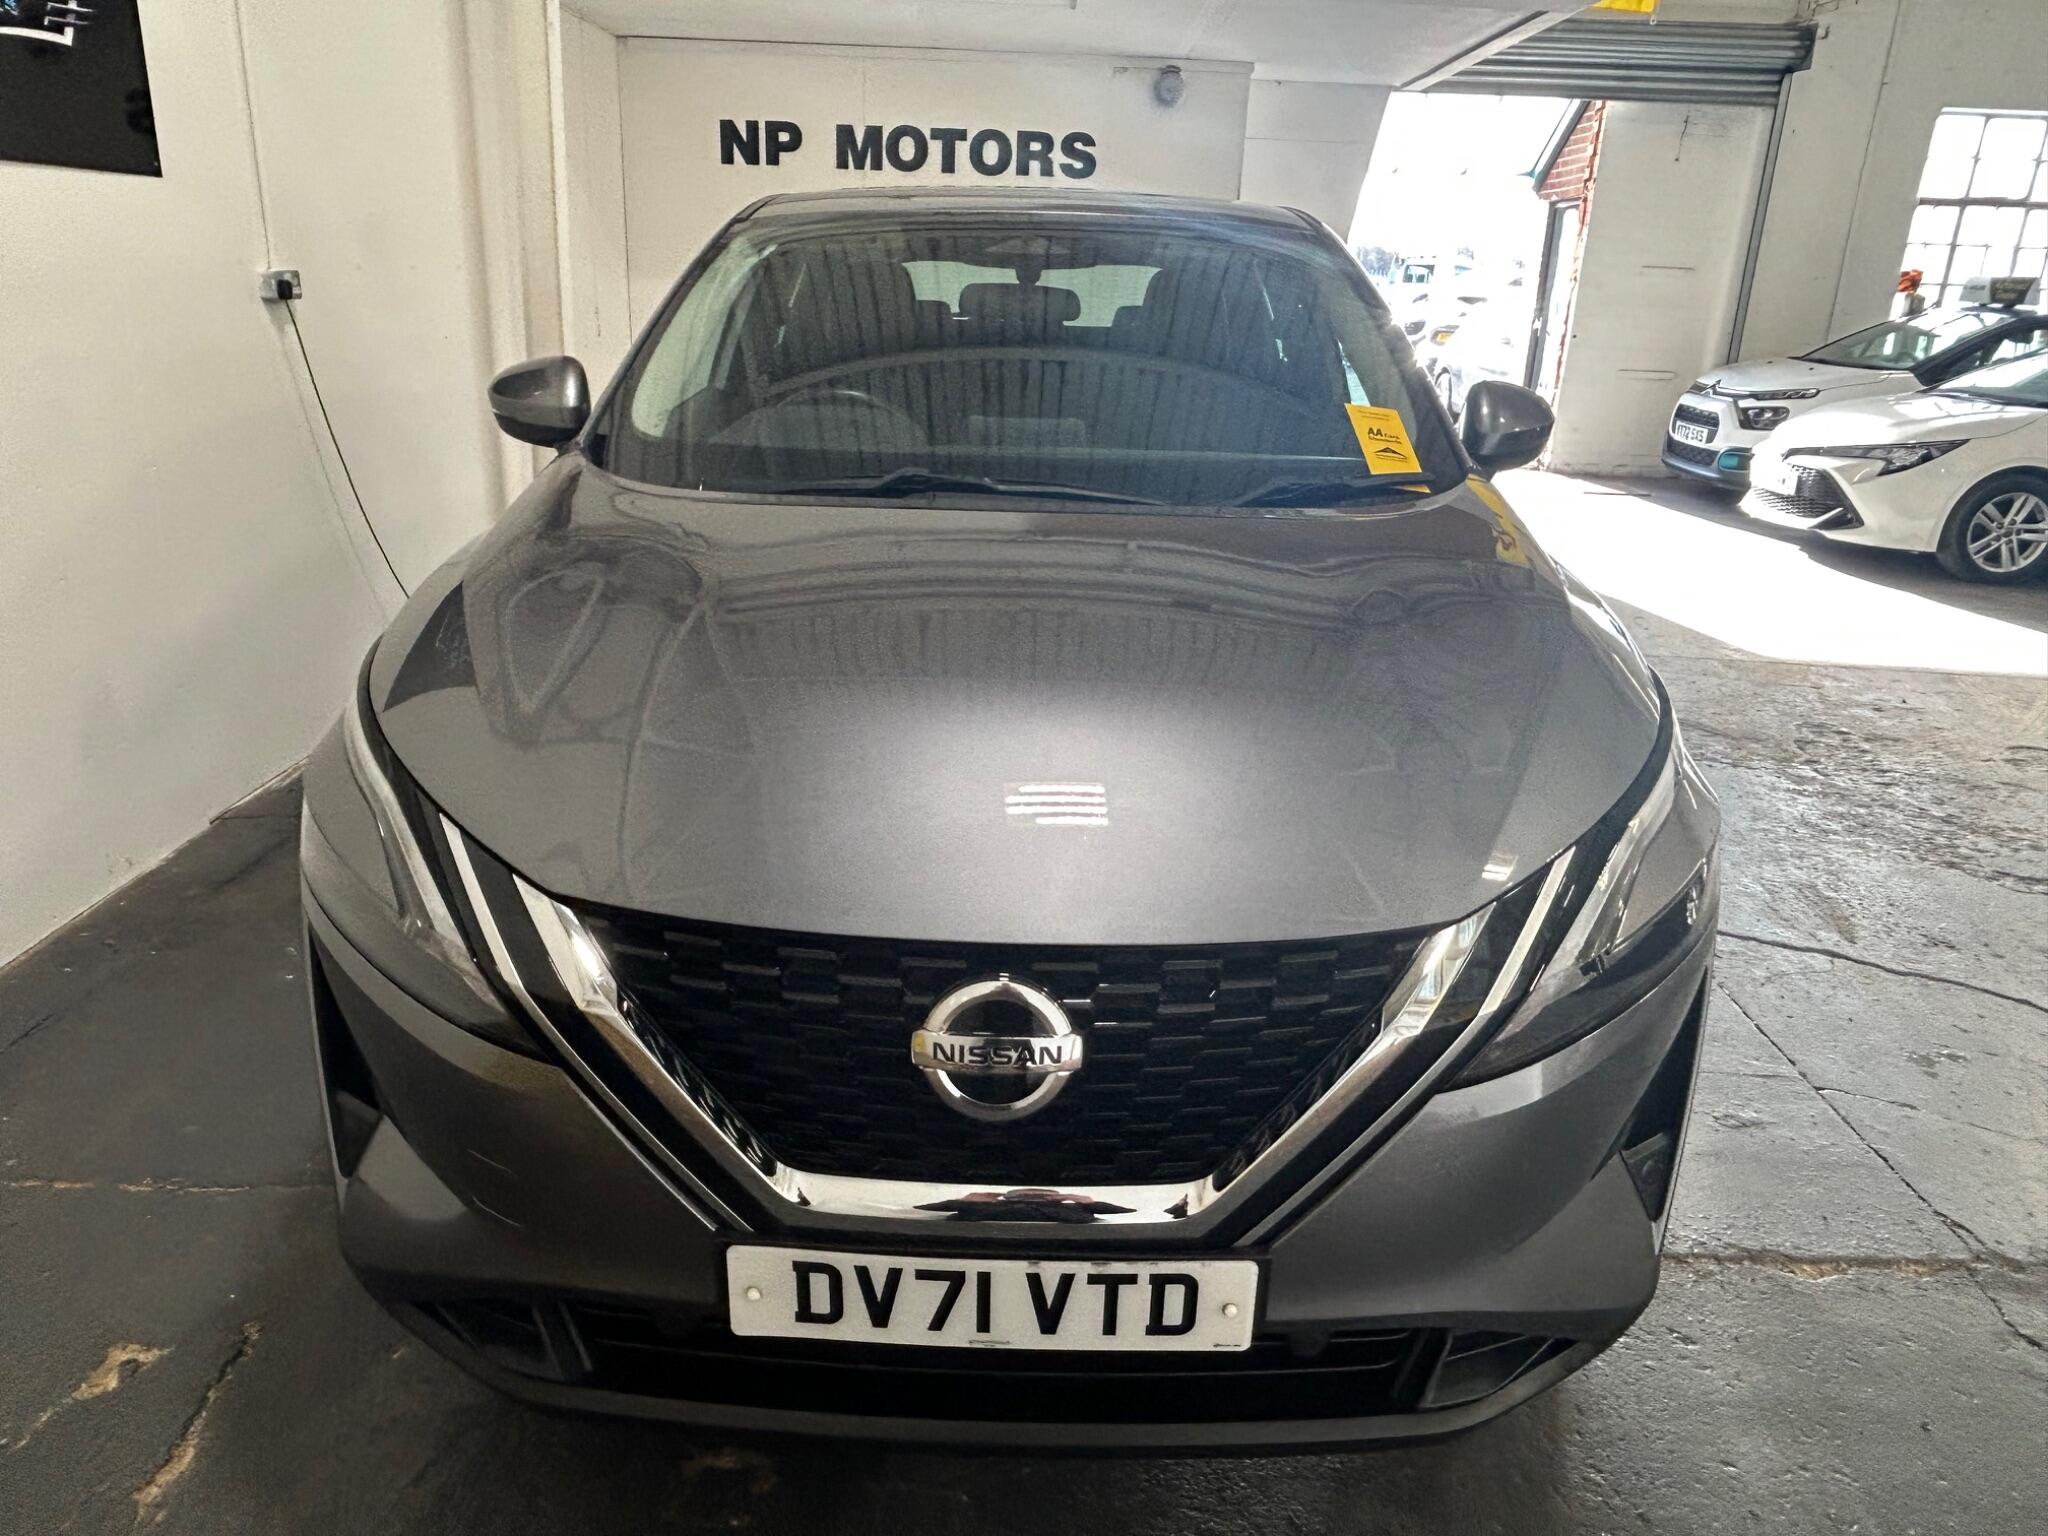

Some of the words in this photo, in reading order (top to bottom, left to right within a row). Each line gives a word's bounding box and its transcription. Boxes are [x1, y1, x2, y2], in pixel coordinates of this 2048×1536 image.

[719, 119, 803, 167] NP
[835, 123, 1098, 180] MOTORS
[1368, 427, 1383, 438] AA
[932, 1042, 1063, 1066] NISSAN
[791, 1260, 992, 1334] DV71
[1024, 1271, 1200, 1337] VTD
